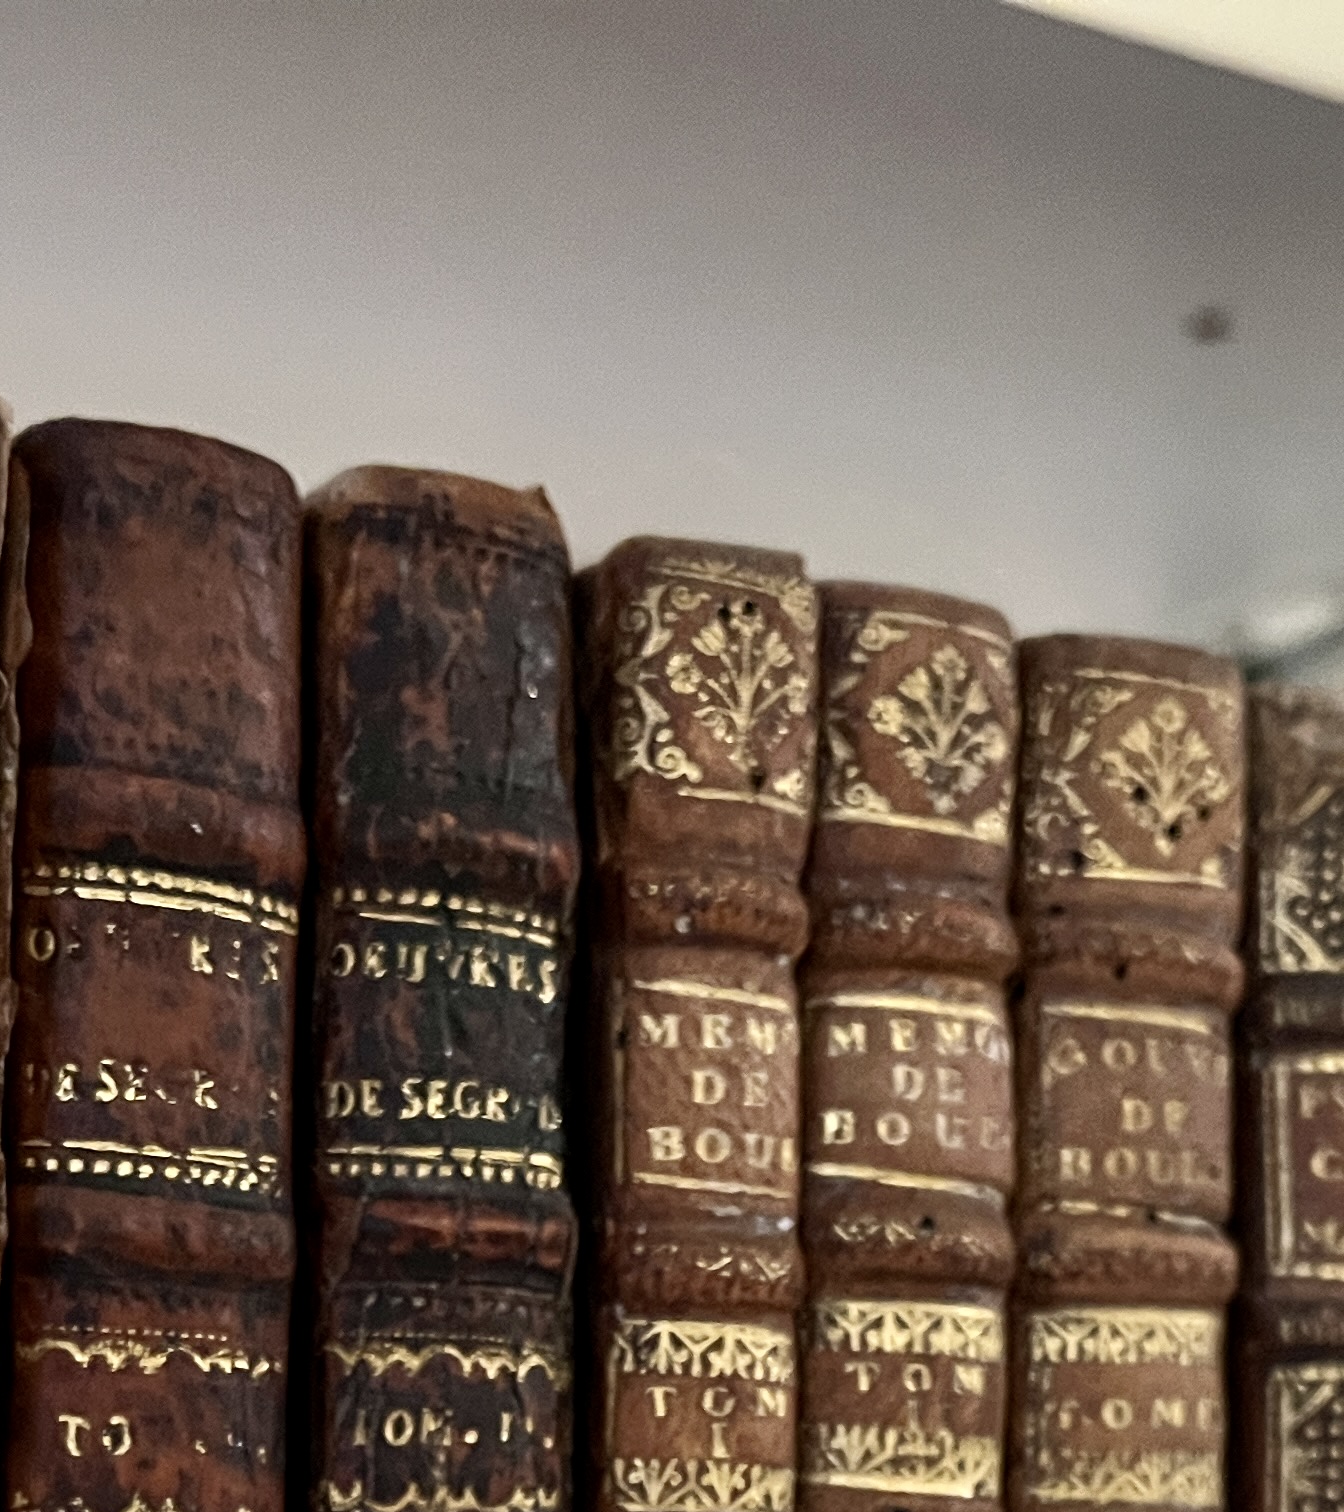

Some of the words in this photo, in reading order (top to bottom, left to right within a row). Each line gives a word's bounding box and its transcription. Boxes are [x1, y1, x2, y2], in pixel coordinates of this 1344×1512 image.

[324, 1079, 385, 1119] DE
[691, 1069, 772, 1107] DE
[892, 1063, 968, 1102] DE
